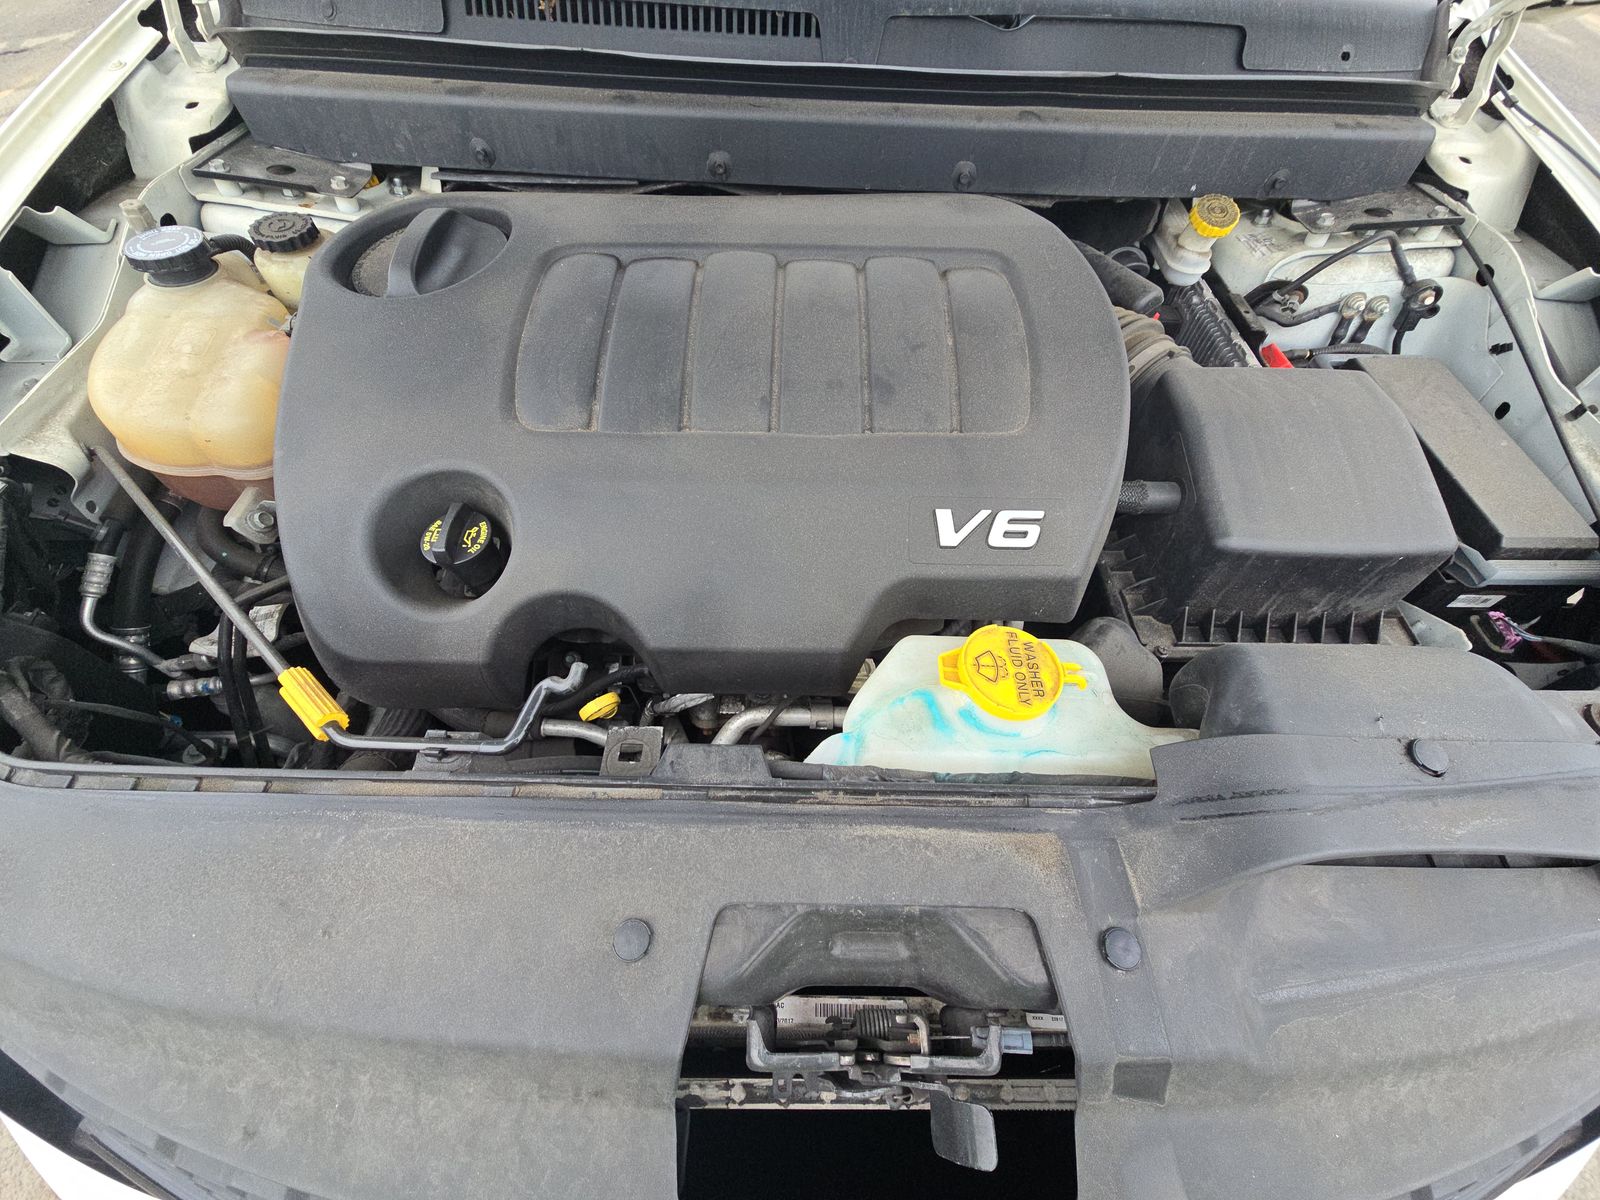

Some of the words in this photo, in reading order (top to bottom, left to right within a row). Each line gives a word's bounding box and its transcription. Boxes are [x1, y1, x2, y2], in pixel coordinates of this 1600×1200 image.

[478, 521, 488, 544] ENGINE
[933, 508, 1045, 549] V6
[467, 543, 481, 554] OIL
[1005, 631, 1024, 669] FLUID
[1023, 641, 1045, 698] WASHER
[1014, 671, 1033, 706] ONLY
